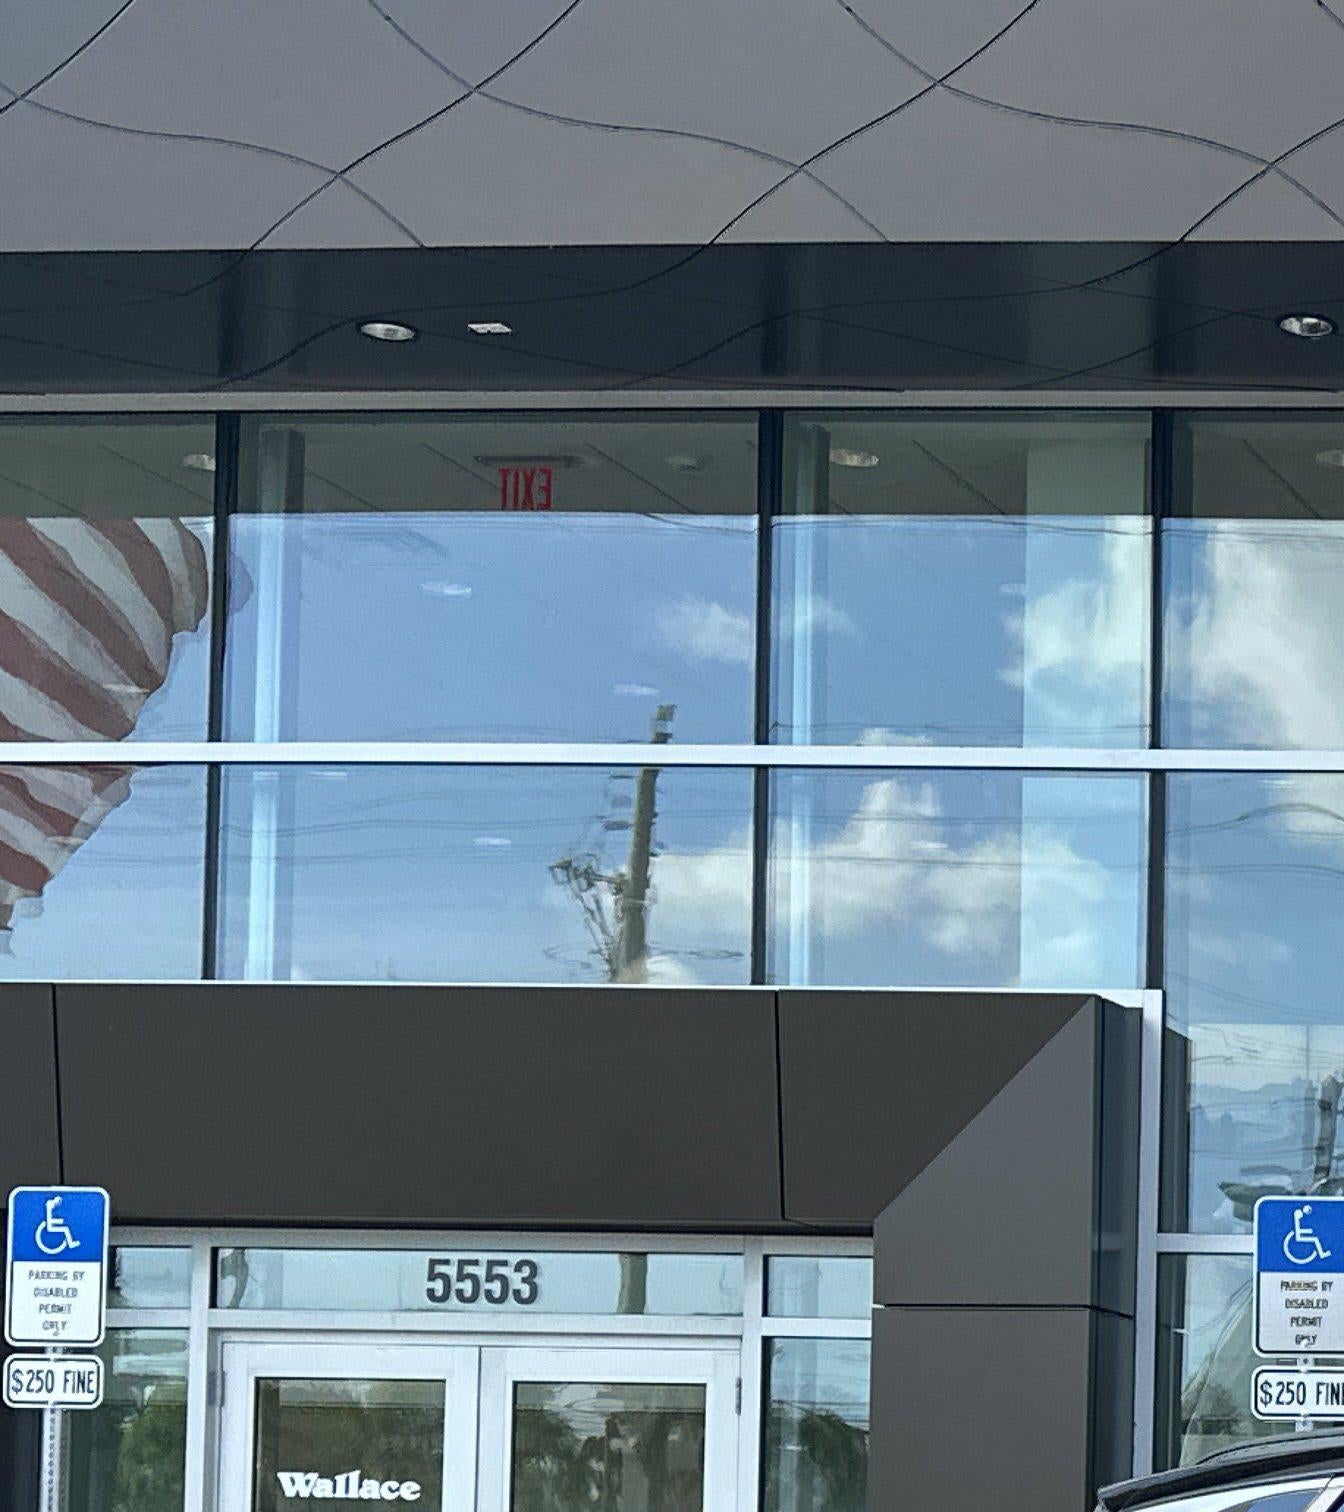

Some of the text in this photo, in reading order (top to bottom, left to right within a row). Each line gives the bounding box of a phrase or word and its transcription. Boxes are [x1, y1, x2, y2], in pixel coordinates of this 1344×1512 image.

[29, 1270, 85, 1281] PARKING BY
[426, 1257, 539, 1306] 5553
[1280, 1280, 1334, 1292] PARKING BY
[33, 1287, 78, 1298] DISABLED
[38, 1304, 72, 1314] PERMIT
[1284, 1299, 1329, 1310] DISABLED
[1290, 1316, 1323, 1327] PERMIT
[12, 1368, 95, 1395] $250 FINE
[1259, 1379, 1307, 1408] $250
[276, 1469, 422, 1501] Wallace
